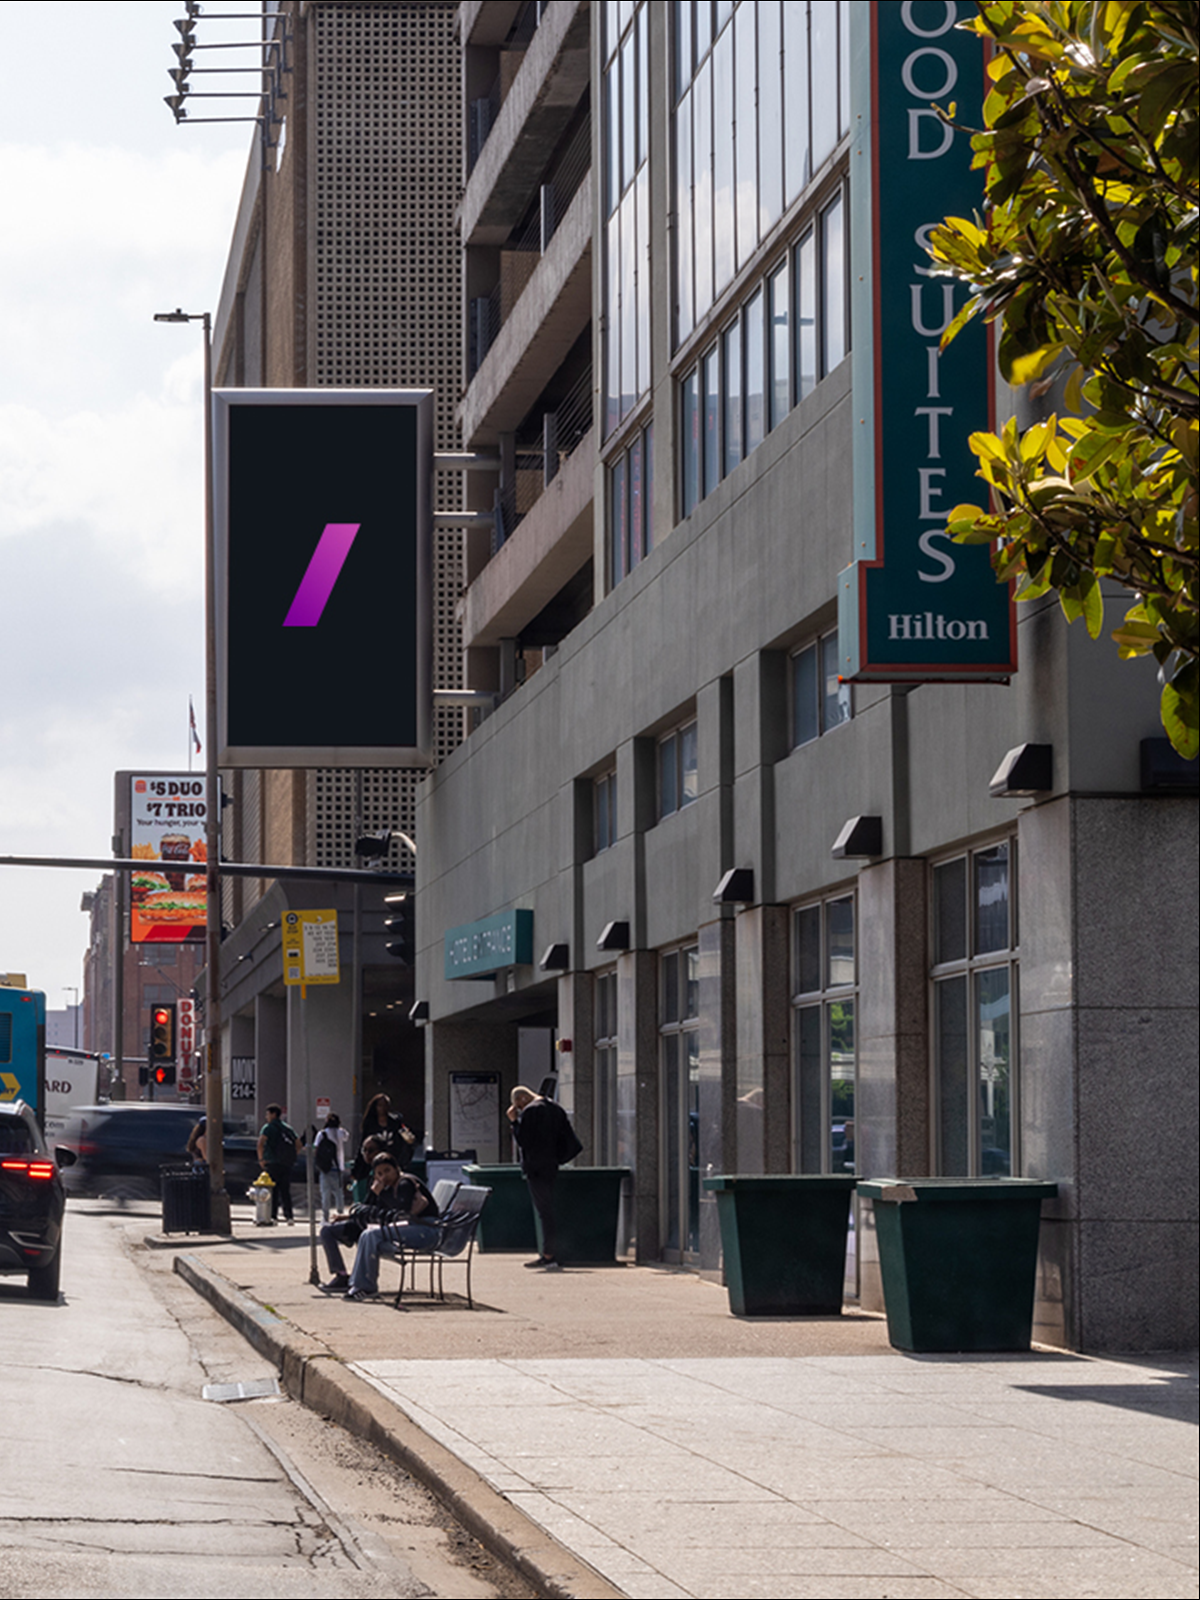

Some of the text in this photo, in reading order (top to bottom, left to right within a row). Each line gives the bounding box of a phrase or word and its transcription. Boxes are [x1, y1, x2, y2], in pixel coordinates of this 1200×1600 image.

[887, 611, 990, 641] Hilton
[150, 781, 166, 796] $5
[167, 781, 203, 796] DUO
[146, 802, 207, 818] $7 TRIO
[136, 818, 153, 826] Your
[179, 1000, 194, 1079] DONUTS
